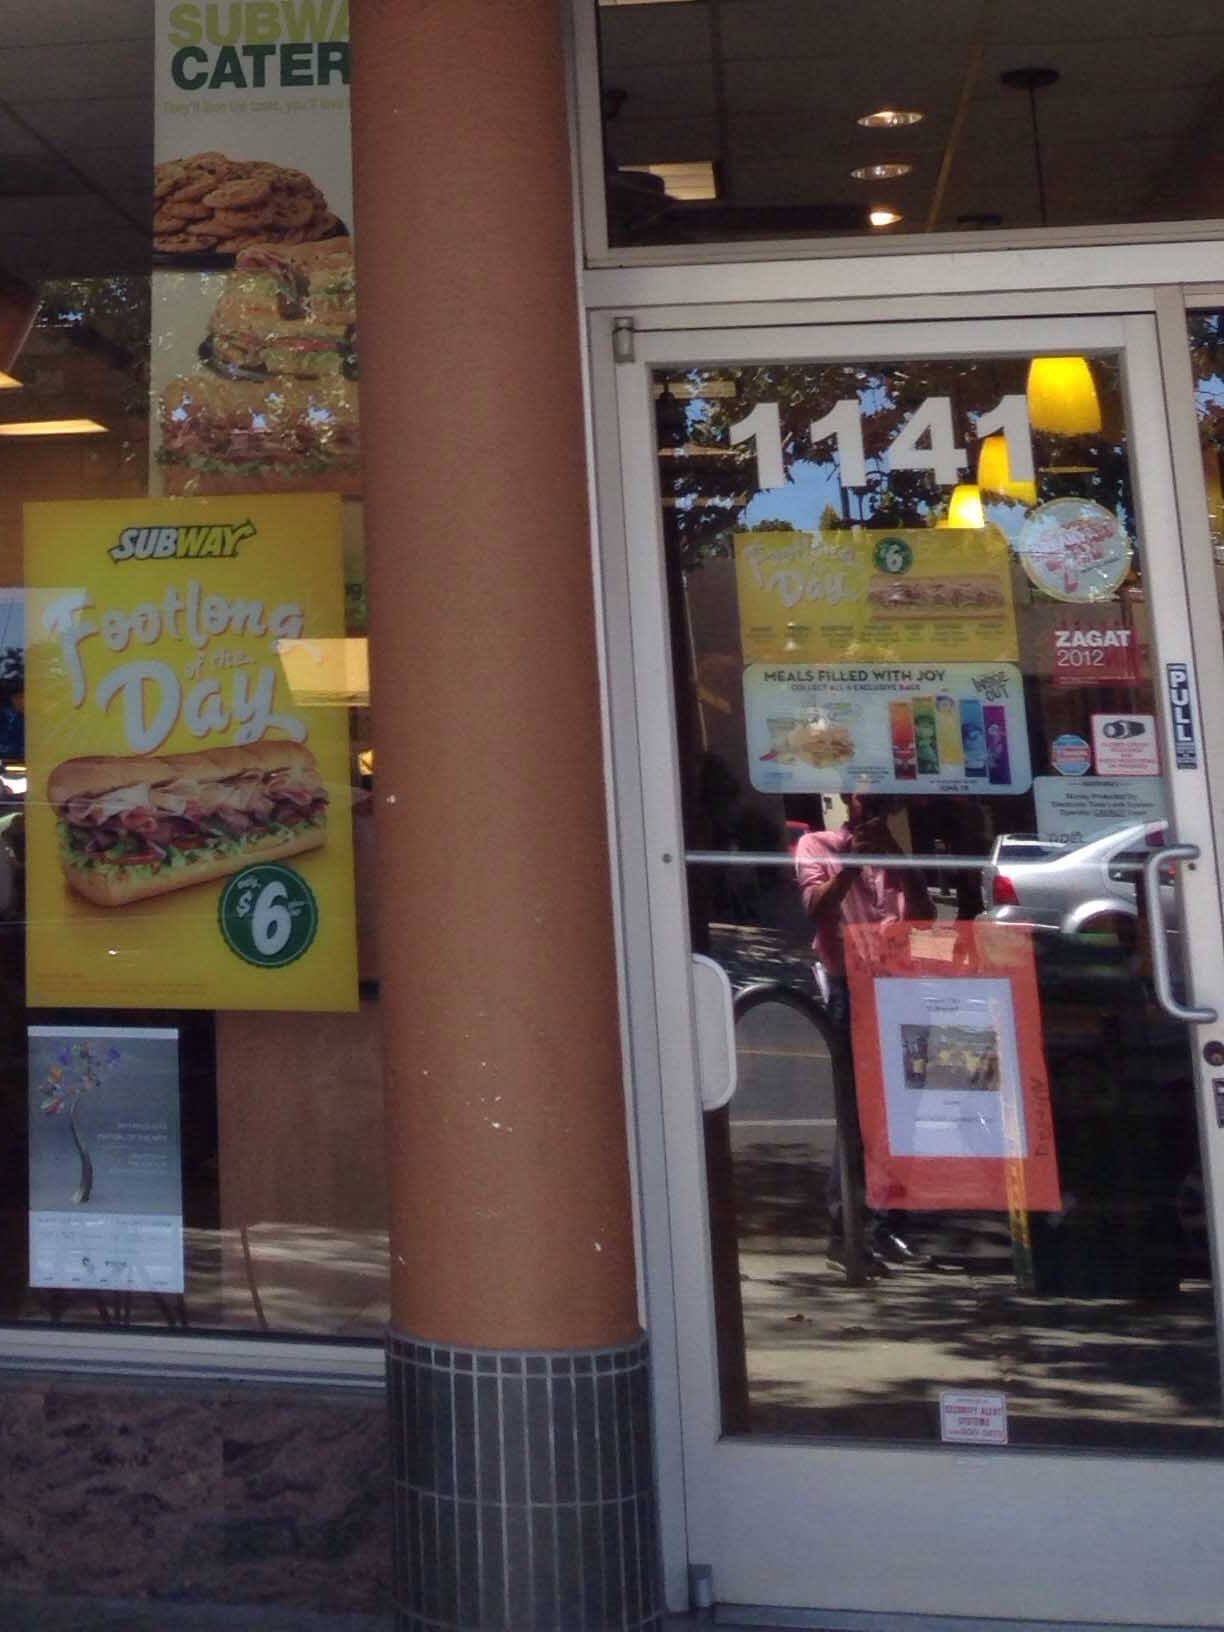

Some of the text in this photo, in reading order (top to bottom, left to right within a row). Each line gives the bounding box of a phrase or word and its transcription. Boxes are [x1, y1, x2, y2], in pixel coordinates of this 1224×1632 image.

[171, 42, 351, 91] CATER
[730, 393, 1036, 489] 1141
[108, 518, 258, 564] SUBWAY
[769, 567, 857, 608] Day
[41, 579, 322, 710] Footlong
[1055, 629, 1131, 648] ZAGAT
[1057, 649, 1105, 667] 2012
[764, 670, 945, 682] MEALS FILLED WITH JOY
[95, 660, 309, 755] Day
[1170, 670, 1193, 741] PULL
